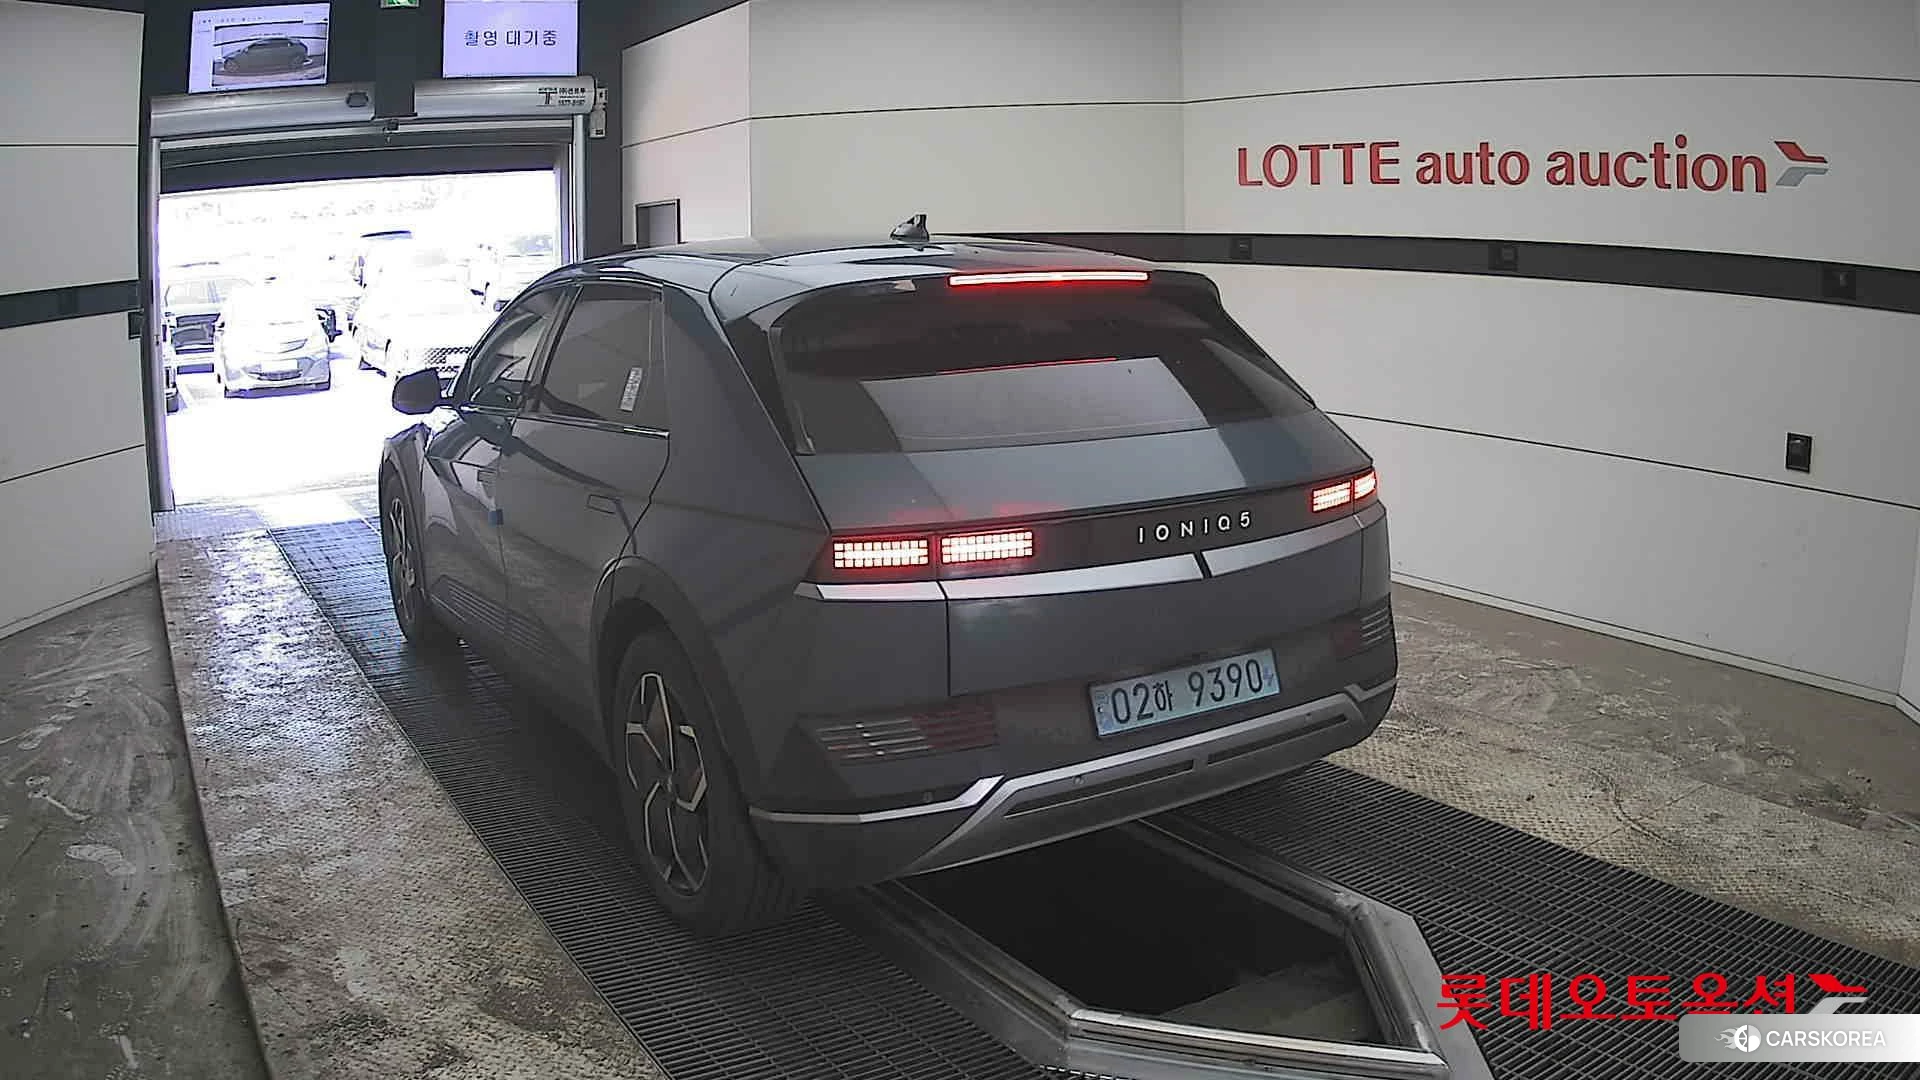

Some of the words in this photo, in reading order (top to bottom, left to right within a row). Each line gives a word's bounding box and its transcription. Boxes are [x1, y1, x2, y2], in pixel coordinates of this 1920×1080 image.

[464, 30, 497, 46] 촬영
[506, 30, 557, 46] 대기중
[1237, 141, 1401, 188] LOTTE
[1415, 142, 1530, 186] auto
[1546, 133, 1767, 193] auction
[1111, 680, 1174, 724] 02하
[1188, 659, 1263, 707] 9390
